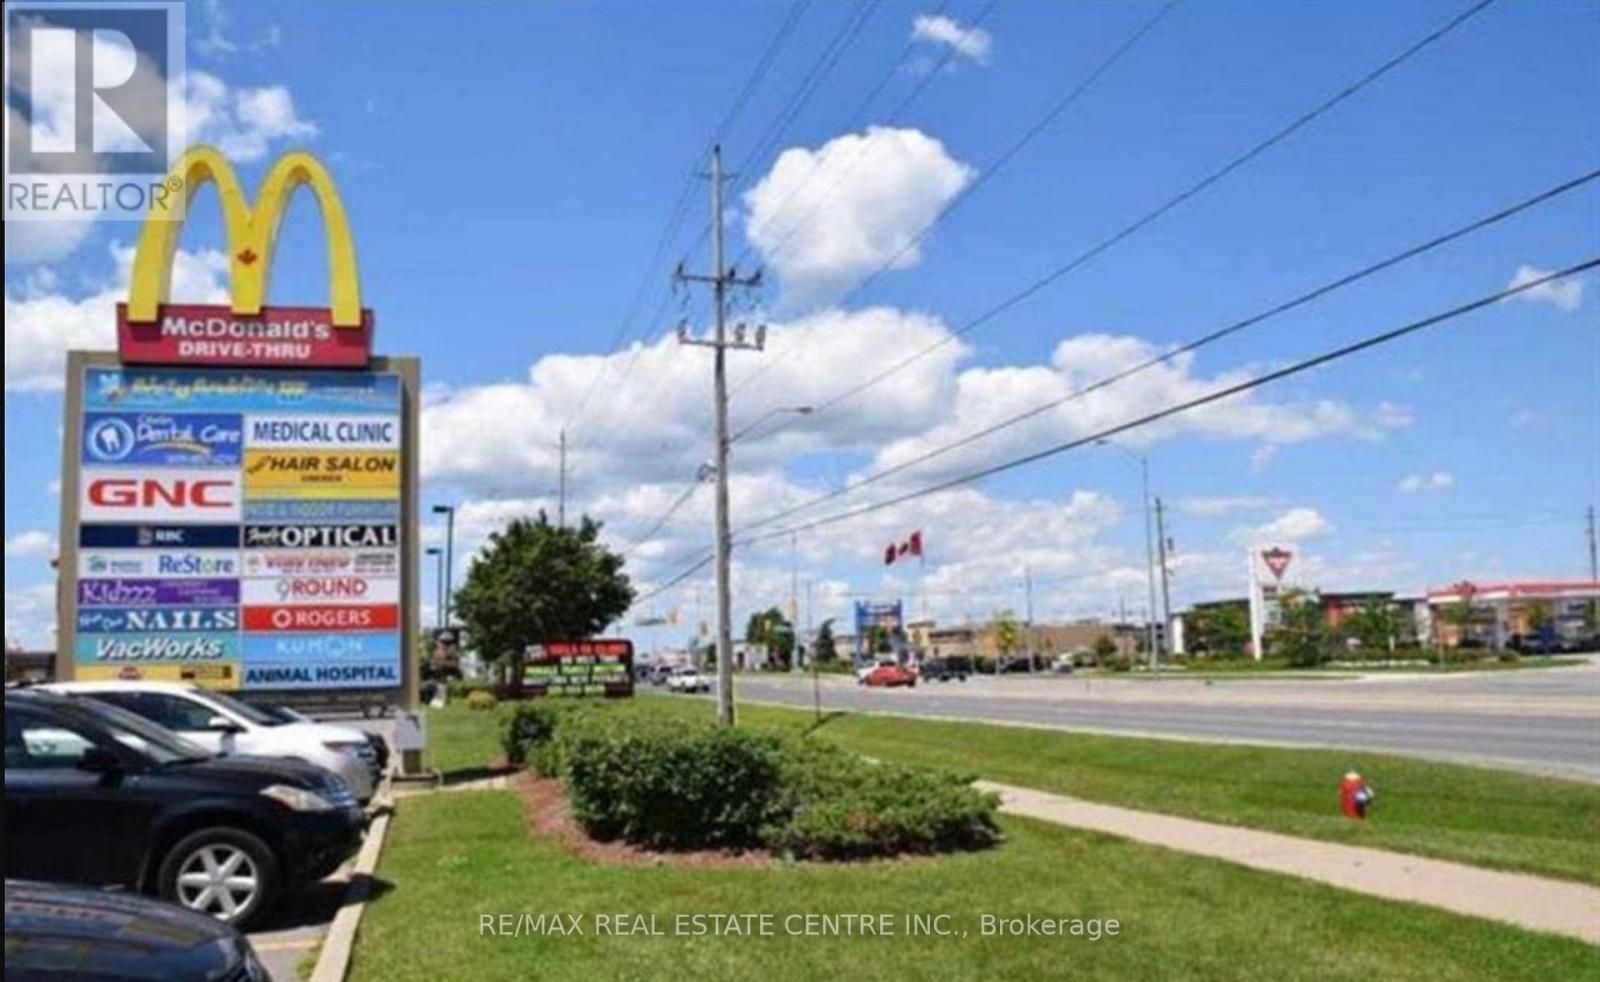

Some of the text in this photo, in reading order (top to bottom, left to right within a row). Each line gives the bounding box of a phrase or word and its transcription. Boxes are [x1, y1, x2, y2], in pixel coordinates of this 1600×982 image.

[161, 317, 331, 339] McDonald's
[178, 341, 312, 359] DRIVE-THRU
[254, 421, 392, 443] MEDICAL CLINIC
[270, 457, 396, 471] HAIR SALON
[88, 479, 234, 508] GNC
[281, 527, 395, 547] OPTICAL
[158, 554, 234, 574] ReStore
[126, 610, 236, 629] NAILS
[296, 609, 372, 626] ROGERS
[95, 636, 222, 660] VacWorks
[246, 667, 312, 682] ANIMAL
[316, 665, 396, 681] HOSPITAL
